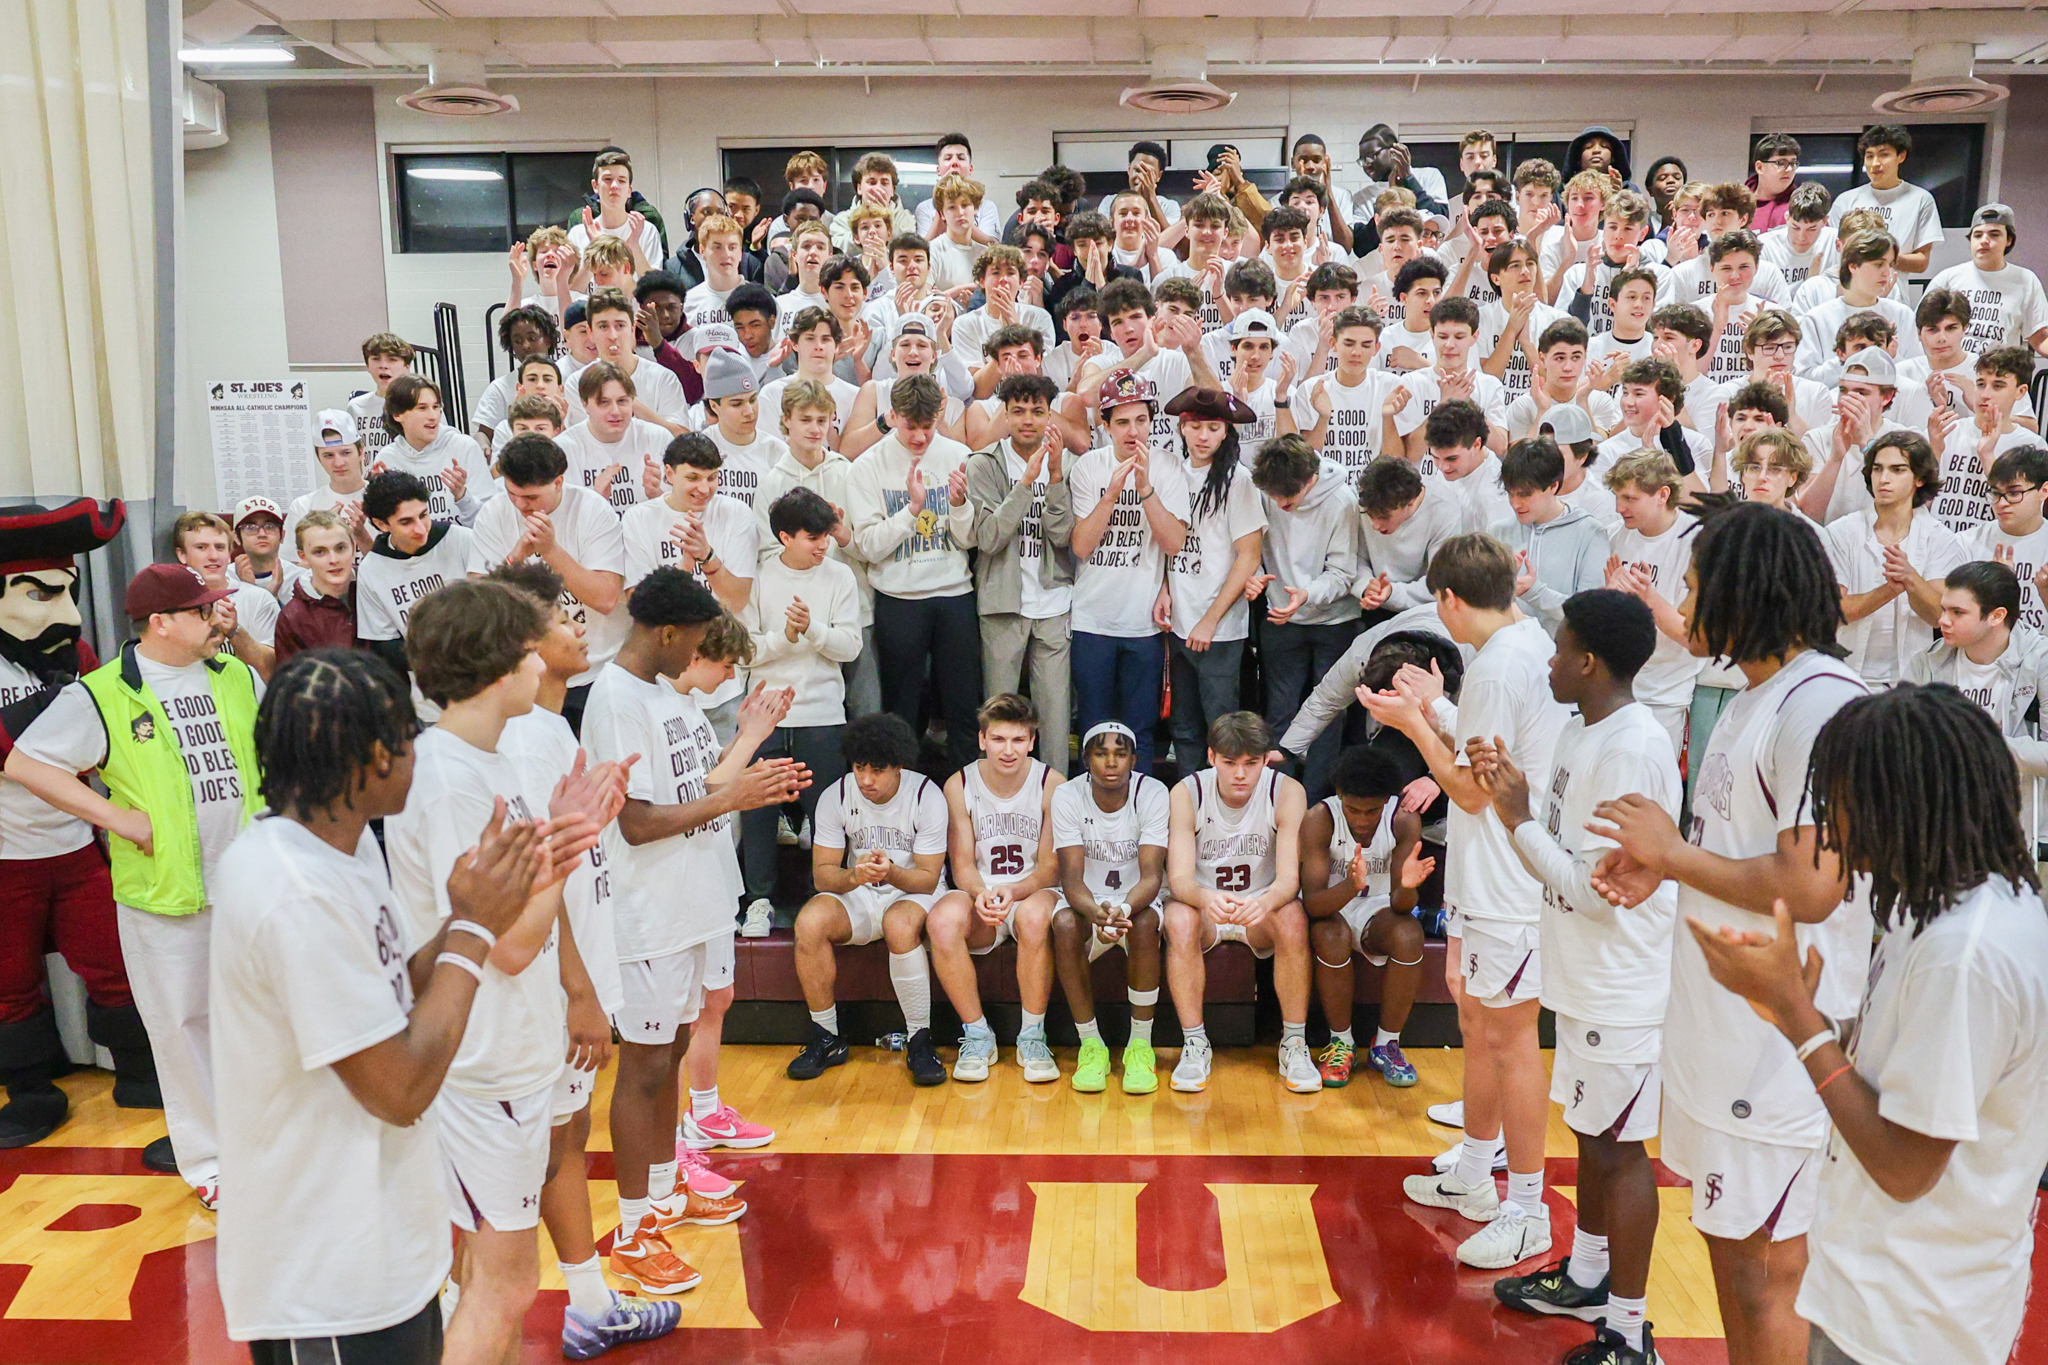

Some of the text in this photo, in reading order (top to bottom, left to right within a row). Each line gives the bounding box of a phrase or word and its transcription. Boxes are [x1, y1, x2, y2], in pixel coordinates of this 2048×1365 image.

[1792, 267, 1809, 282] GOO
[1698, 280, 1711, 294] BE
[1974, 290, 2004, 306] GOOD,
[696, 311, 707, 326] BE
[1388, 305, 1406, 319] GOO
[1972, 323, 2005, 344] BLESS,
[230, 382, 283, 393] ST. JOE'S
[1509, 374, 1532, 388] BLES
[1328, 409, 1369, 428] E GOOD,
[1338, 430, 1369, 448] GOOD,
[1949, 454, 1967, 472] BE
[729, 470, 758, 488] GOOD
[1944, 476, 1987, 497] DO GOO
[882, 488, 911, 518] WES
[1938, 498, 1996, 522] GOD BLES
[391, 584, 411, 606] BE
[175, 694, 216, 718] GOOD
[186, 720, 226, 747] GOOD
[201, 749, 239, 773] BLES
[200, 777, 244, 804] JOE'S.
[990, 844, 1024, 875] 25
[1105, 870, 1122, 891] 4
[1215, 864, 1251, 892] 23
